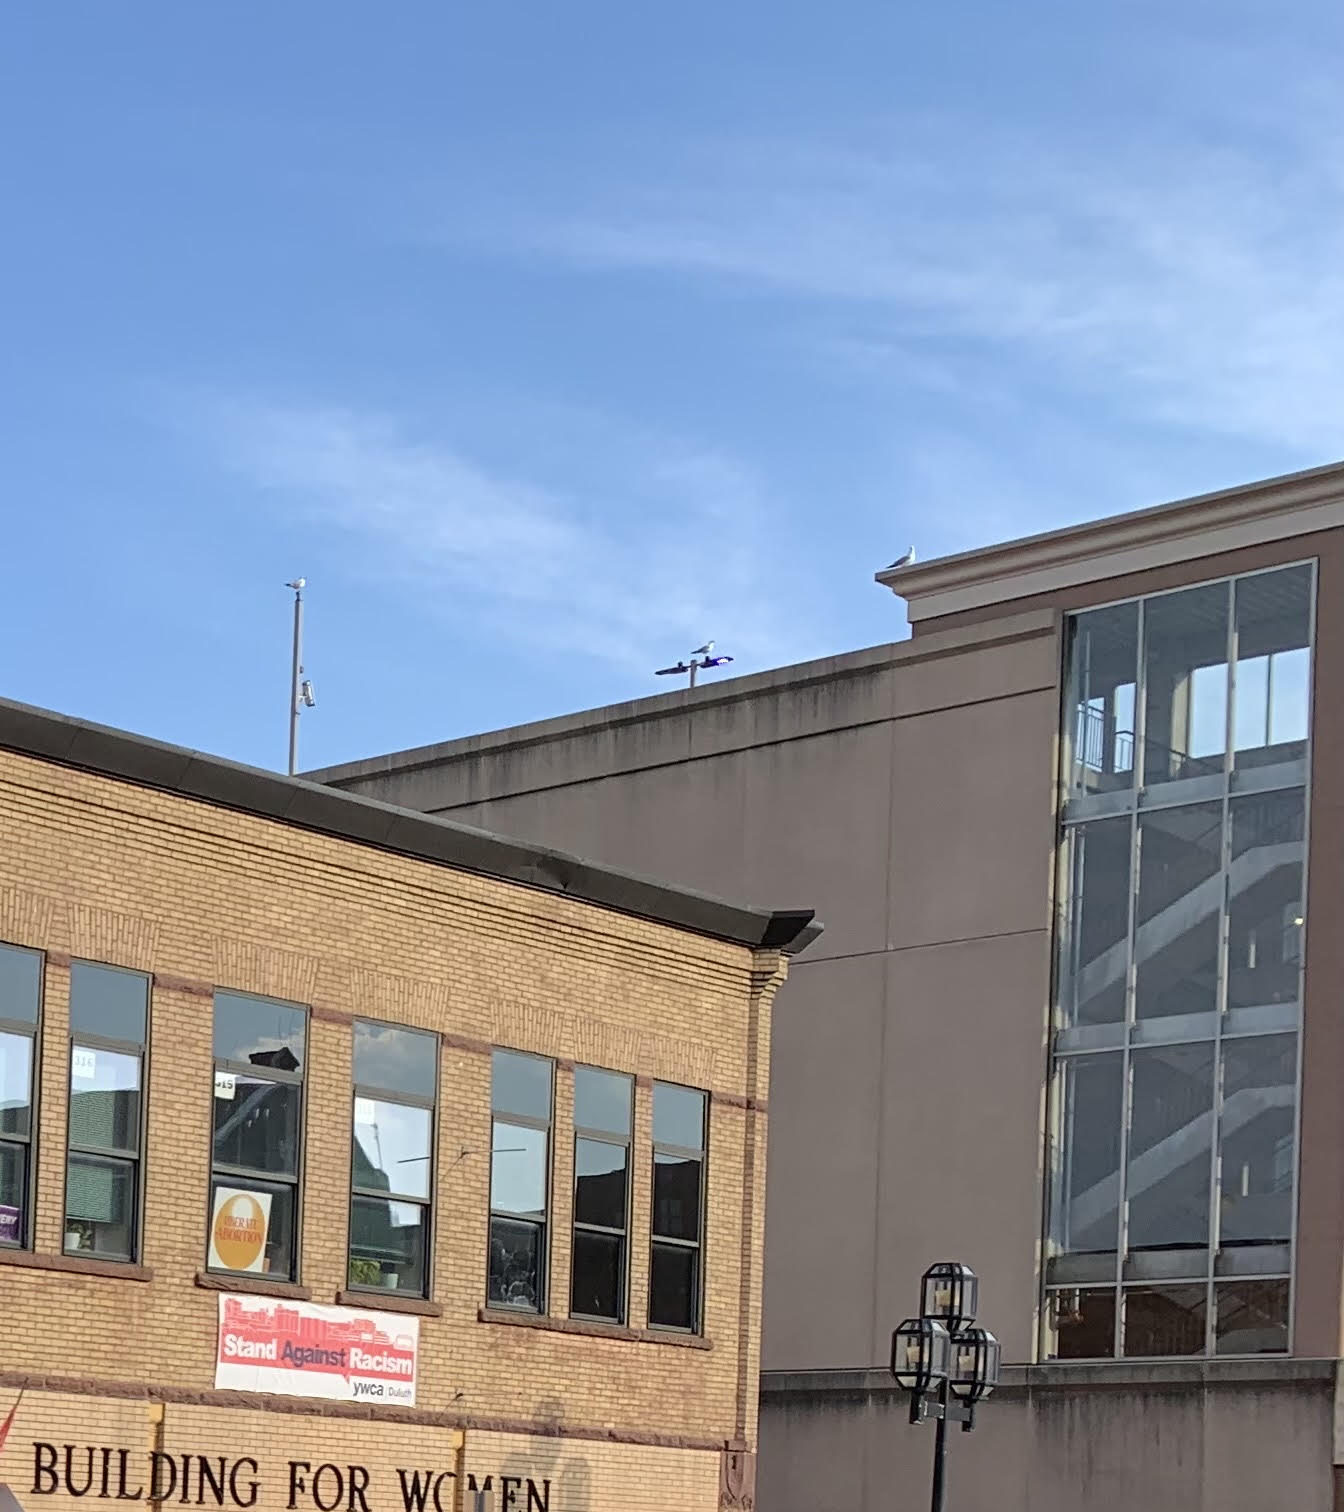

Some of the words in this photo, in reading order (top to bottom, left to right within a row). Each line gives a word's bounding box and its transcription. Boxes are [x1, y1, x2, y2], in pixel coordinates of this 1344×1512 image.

[215, 1228, 263, 1243] ABORTION
[223, 1333, 278, 1360] Stand
[281, 1340, 347, 1368] Against
[349, 1347, 413, 1375] Racism
[353, 1381, 384, 1397] ywca
[30, 1440, 262, 1508] BUILDING
